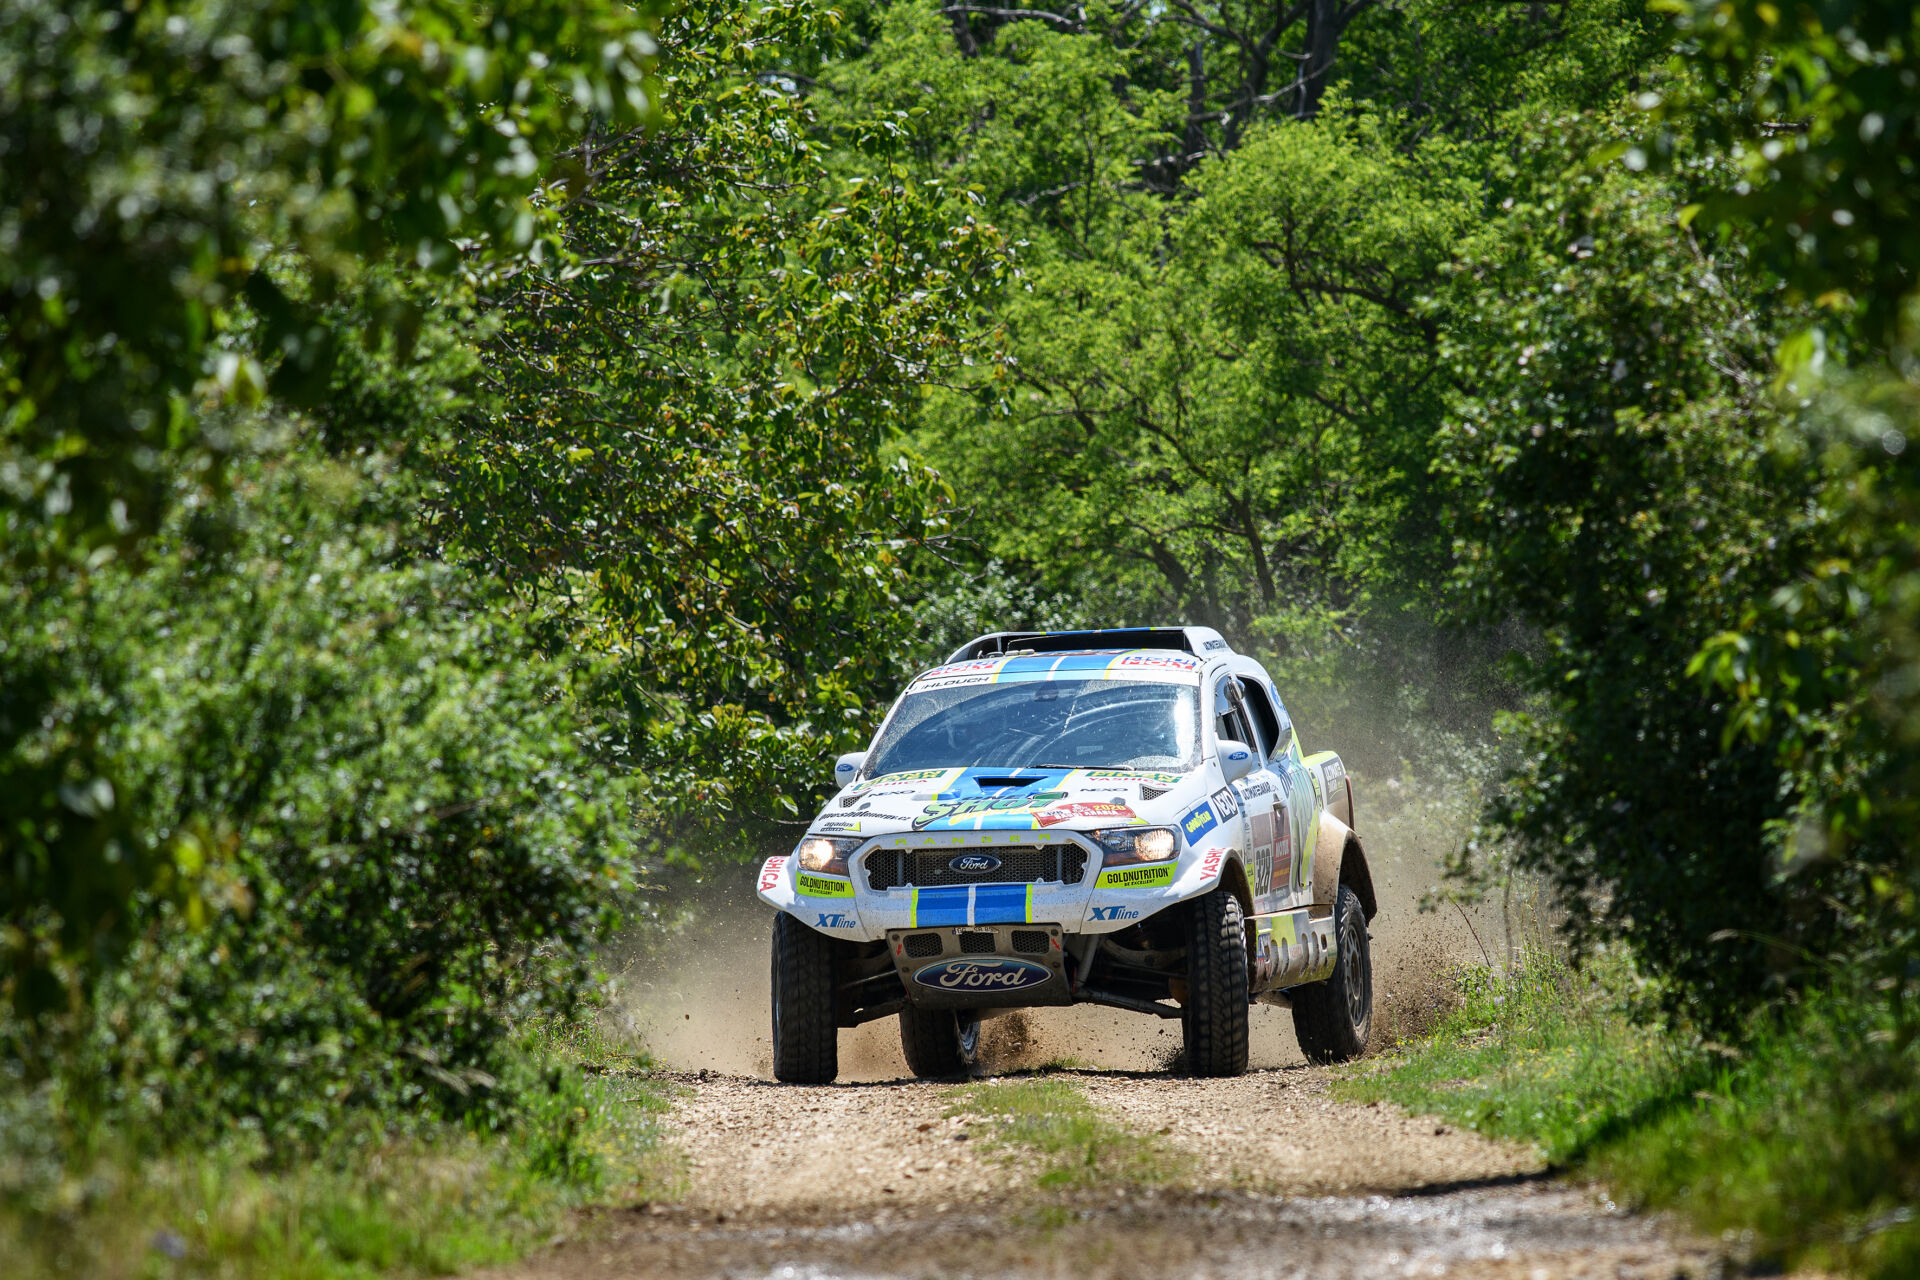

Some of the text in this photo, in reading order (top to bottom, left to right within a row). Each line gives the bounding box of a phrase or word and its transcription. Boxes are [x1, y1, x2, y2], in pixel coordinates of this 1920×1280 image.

[895, 834, 1051, 846] RANGER
[959, 857, 989, 870] Ford
[1200, 847, 1226, 881] YASHI
[799, 875, 845, 892] GOLDNUTRITION
[1107, 867, 1169, 884] GOLDNUTRITION
[939, 961, 1027, 987] Ford
